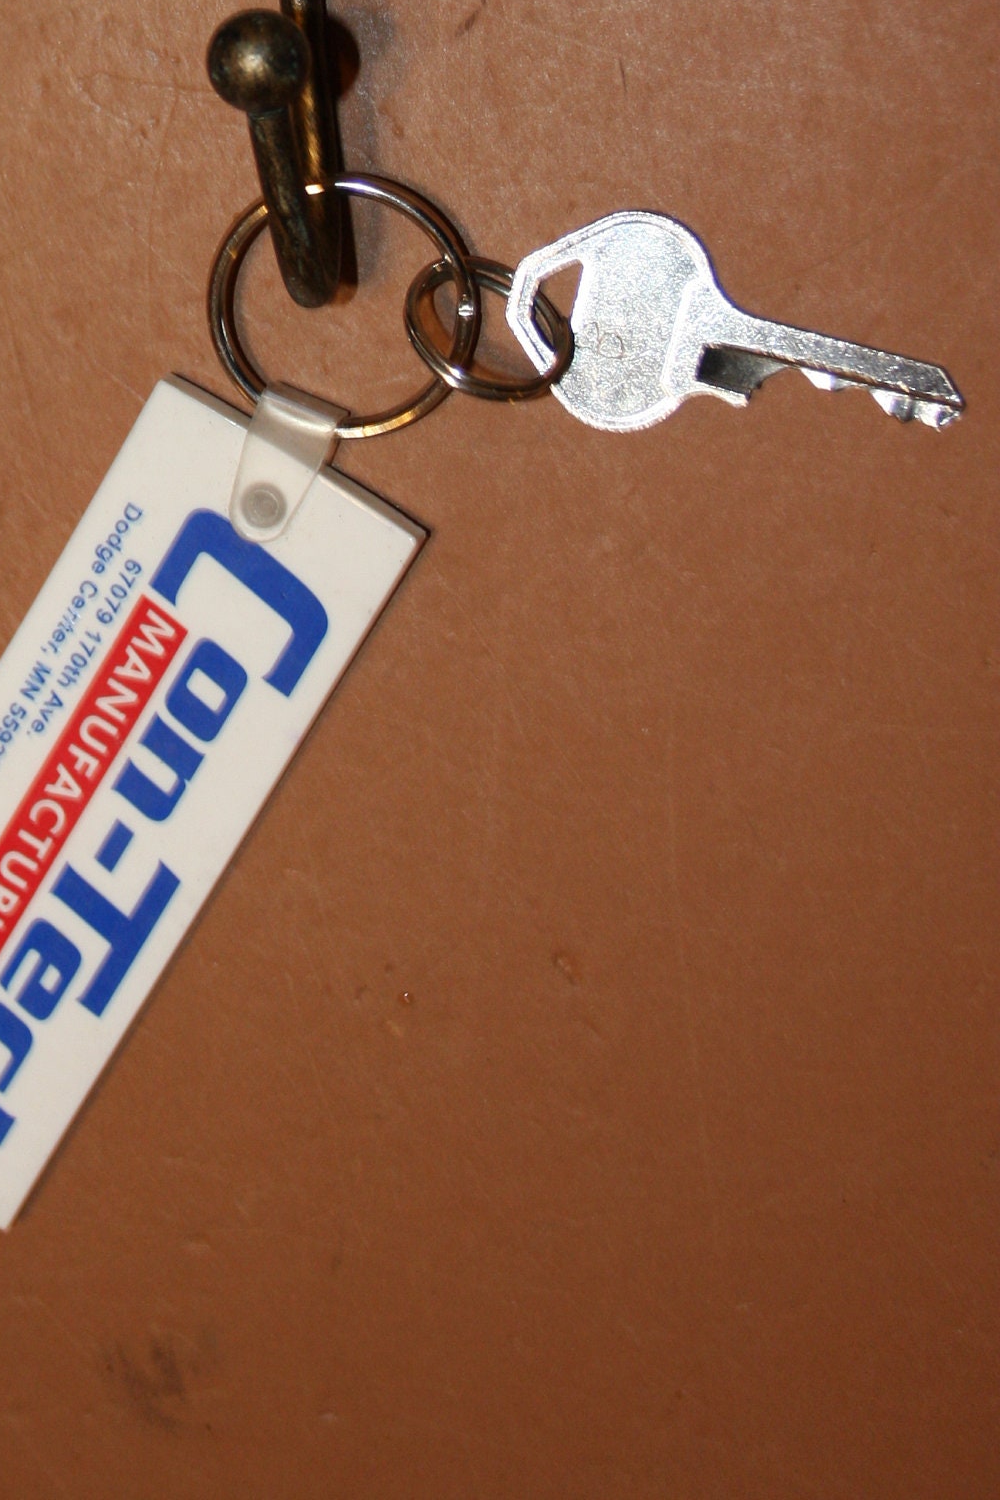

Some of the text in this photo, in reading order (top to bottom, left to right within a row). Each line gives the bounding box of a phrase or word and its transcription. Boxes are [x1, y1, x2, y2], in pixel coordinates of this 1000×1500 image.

[93, 503, 143, 575] Dodge
[20, 662, 52, 703] MN
[27, 560, 143, 734] 67079 170th Ave.
